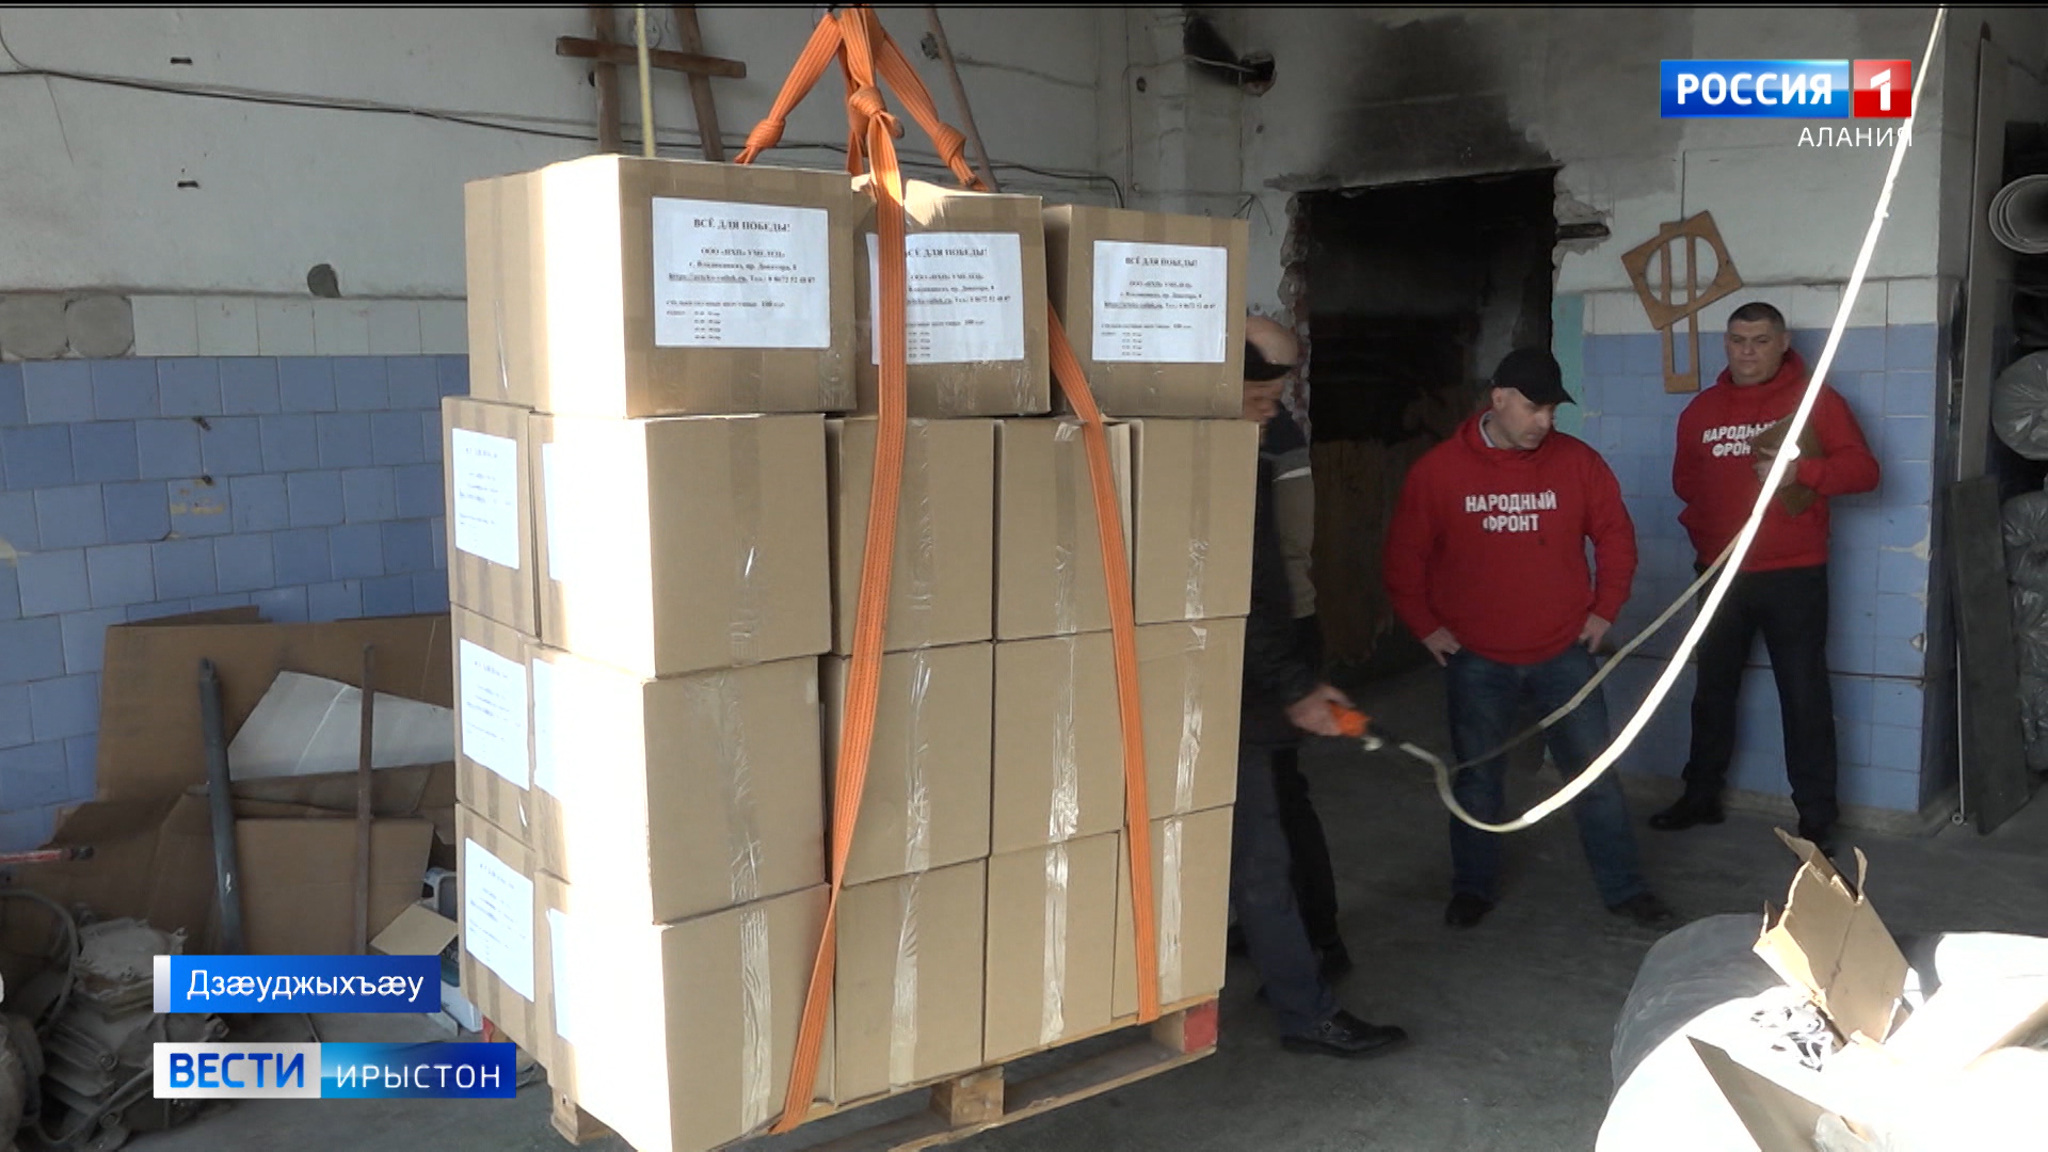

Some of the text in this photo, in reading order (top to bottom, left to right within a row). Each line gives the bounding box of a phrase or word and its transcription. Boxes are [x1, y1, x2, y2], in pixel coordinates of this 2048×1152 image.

[717, 219, 740, 231] ДЛЯ
[742, 221, 791, 232] ПОБЕДЫ!
[1702, 420, 1777, 444] НАРОДНЫ
[1465, 489, 1557, 513] НАРОДНЫЙ
[1482, 513, 1539, 532] ФРОНТ
